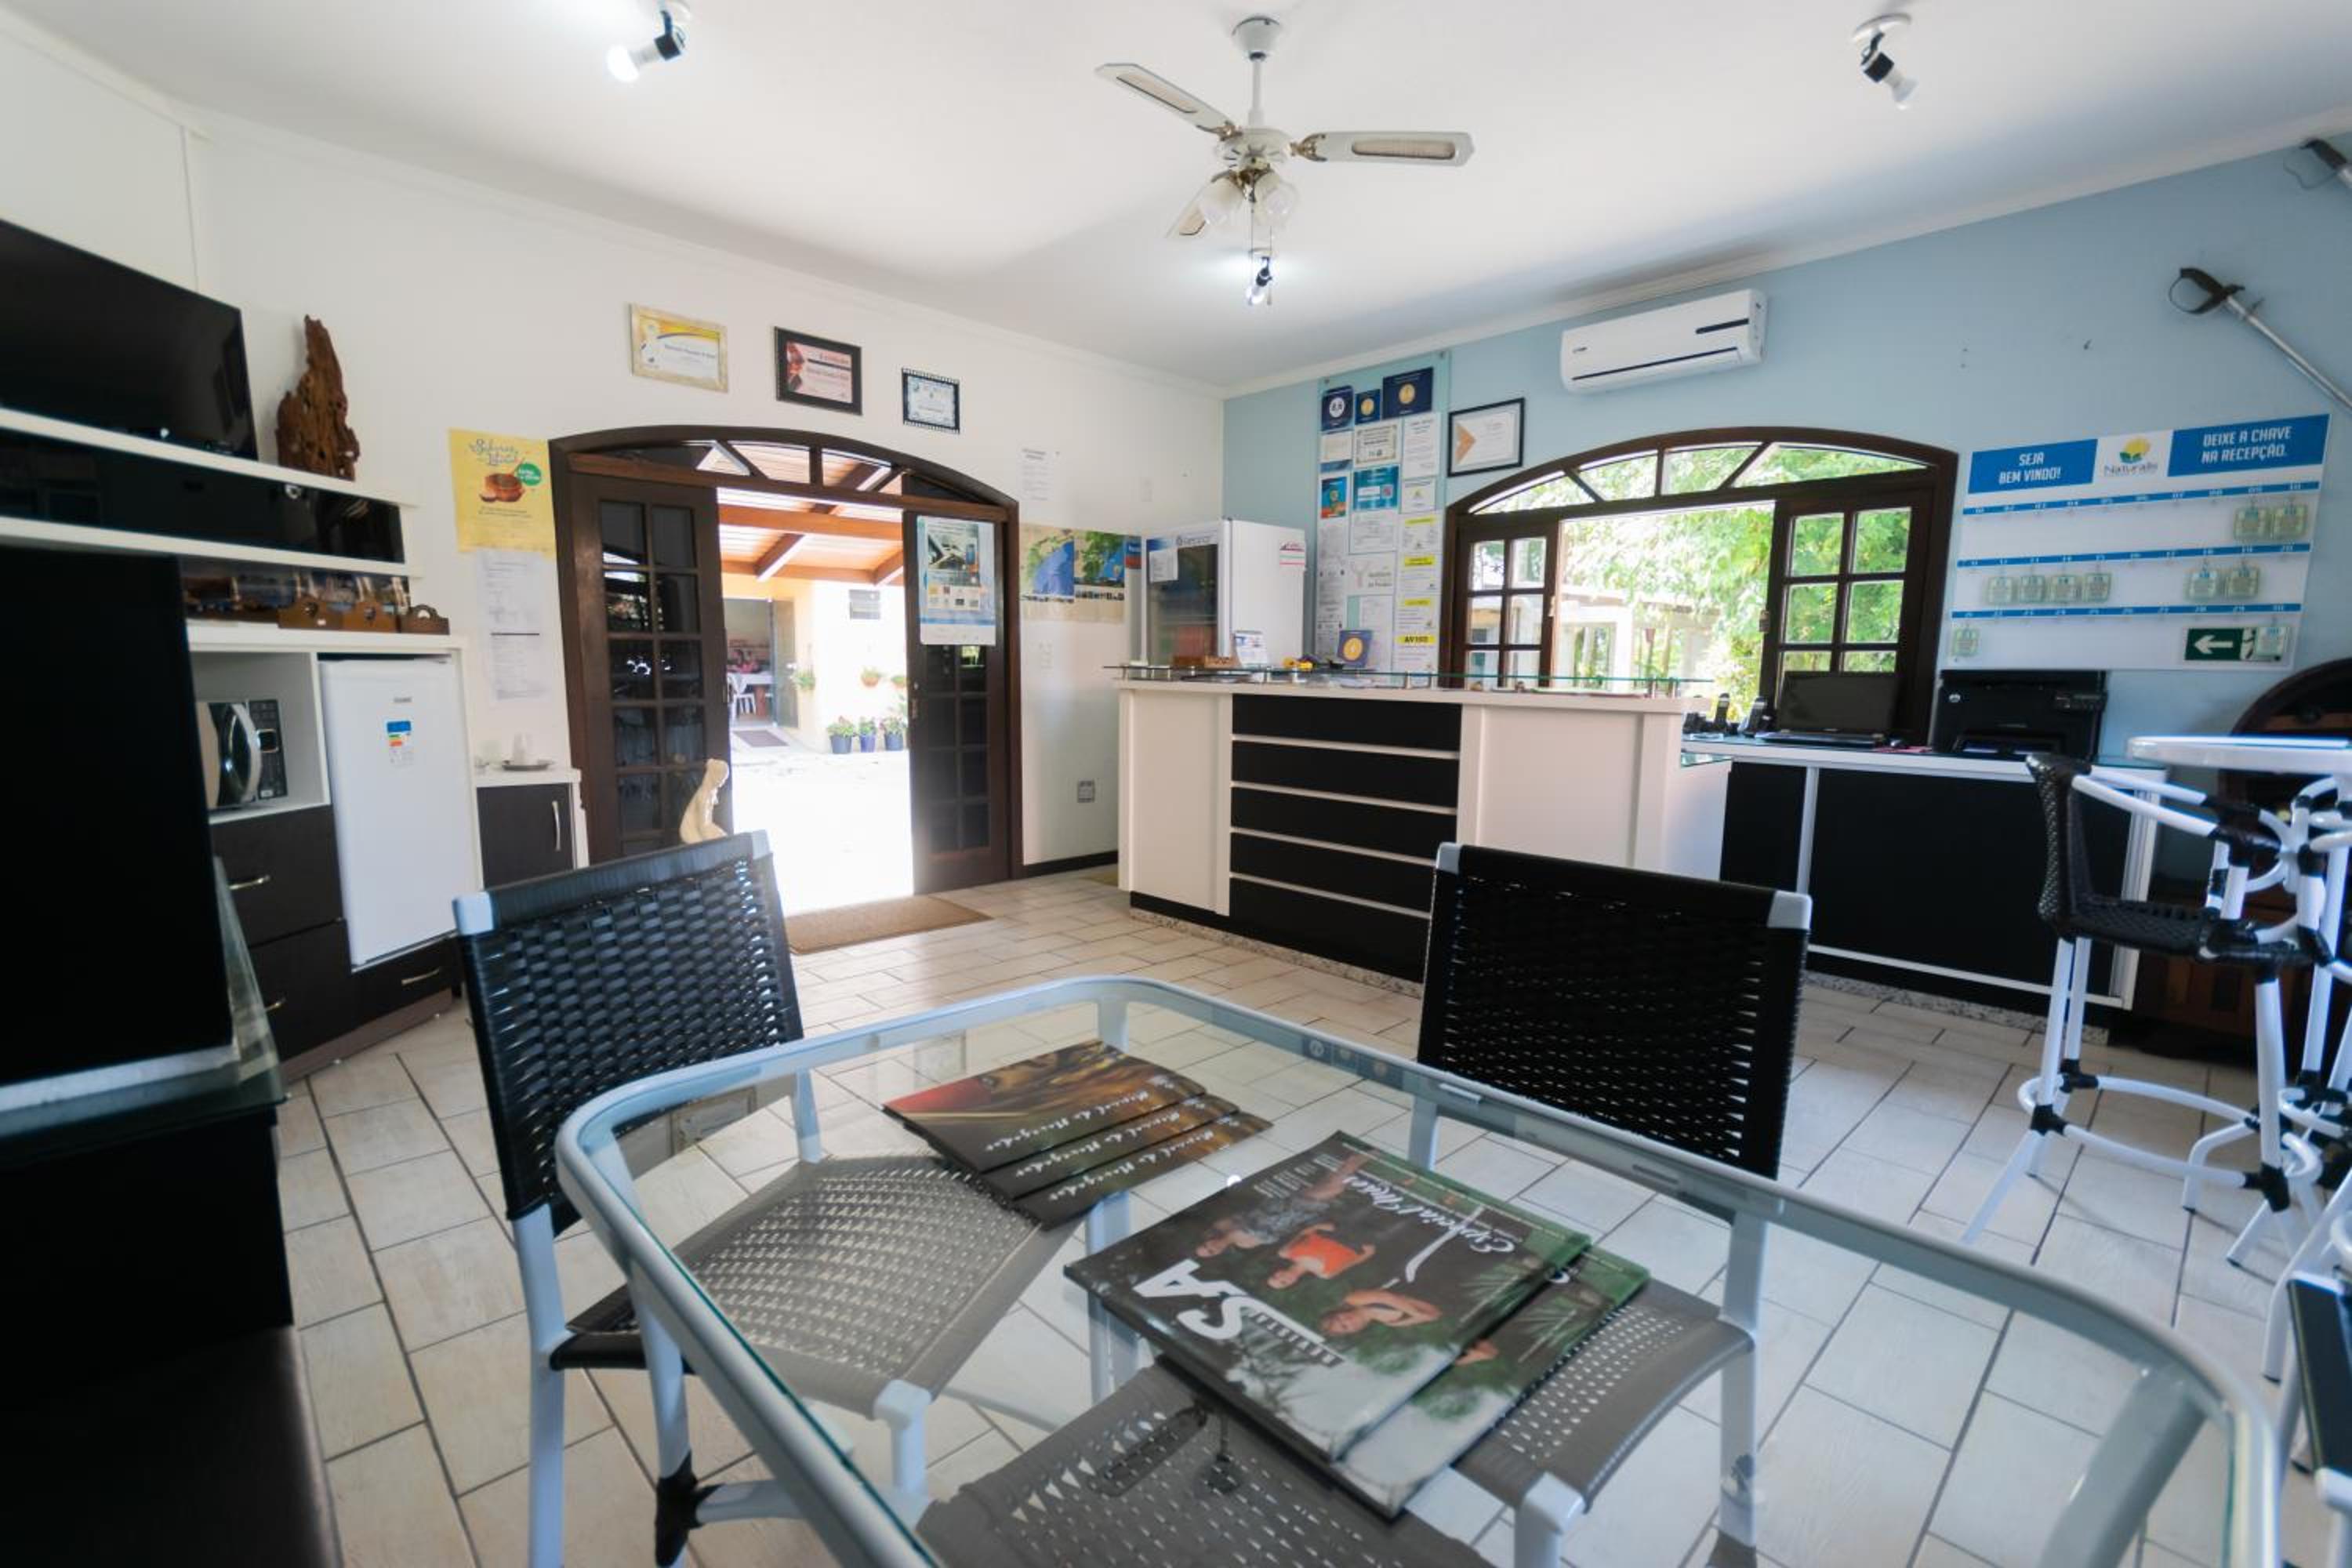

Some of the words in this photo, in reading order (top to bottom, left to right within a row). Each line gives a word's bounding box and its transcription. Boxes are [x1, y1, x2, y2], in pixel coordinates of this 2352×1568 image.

[2203, 432, 2235, 448] DEIXE
[2238, 430, 2248, 444] A
[2251, 426, 2292, 441] CHAVE
[2019, 452, 2045, 466] SEJA
[2201, 449, 2218, 464] NA
[1998, 471, 2020, 485] BEM
[2023, 467, 2061, 482] VINDO!
[1403, 1204, 1515, 1254] Especial
[1132, 1258, 1325, 1341] SA
